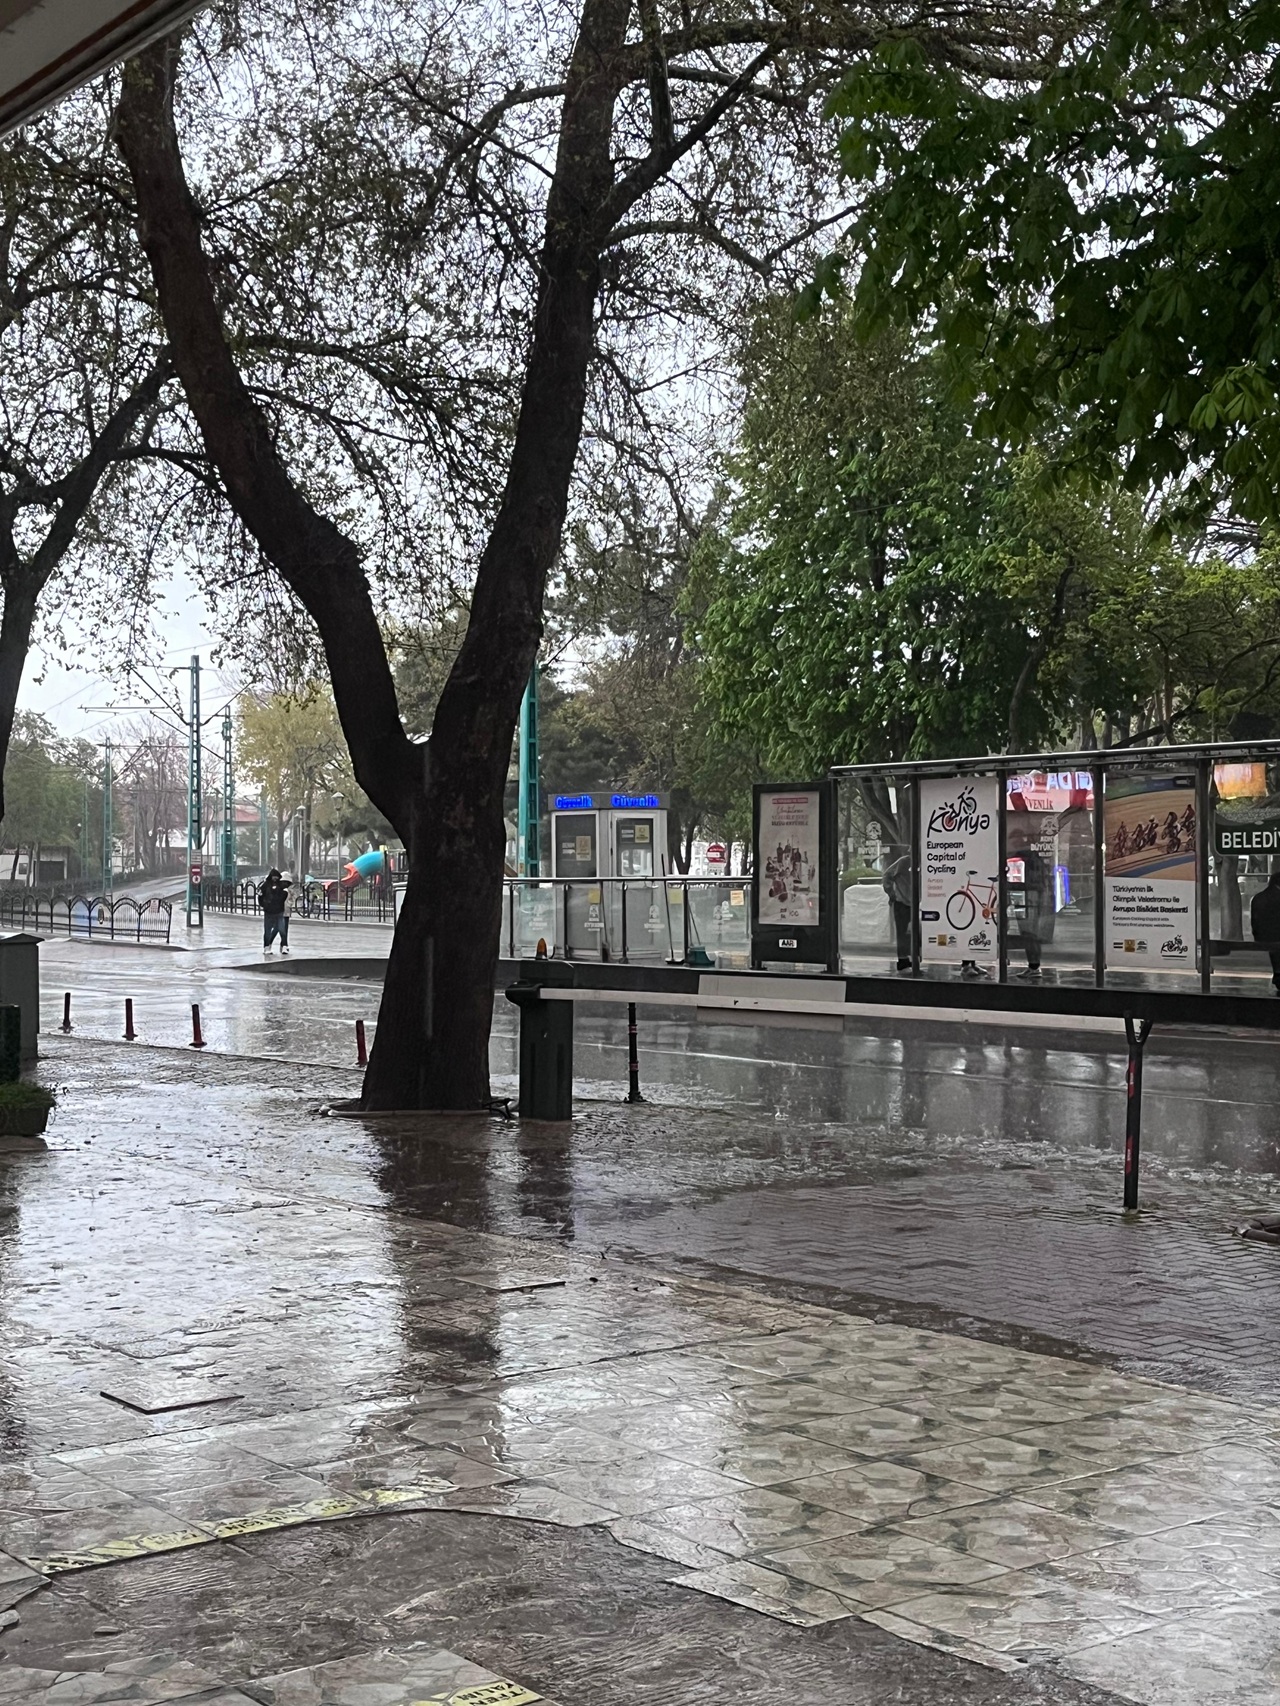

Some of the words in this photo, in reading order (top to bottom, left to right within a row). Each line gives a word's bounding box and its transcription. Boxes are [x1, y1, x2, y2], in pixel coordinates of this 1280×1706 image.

[612, 794, 659, 808] Güvenlik
[927, 802, 990, 838] Konya
[1221, 827, 1280, 849] BELEDİ
[927, 841, 964, 850] European
[927, 852, 957, 862] Capital
[958, 852, 966, 861] of
[927, 864, 956, 874] Cycling
